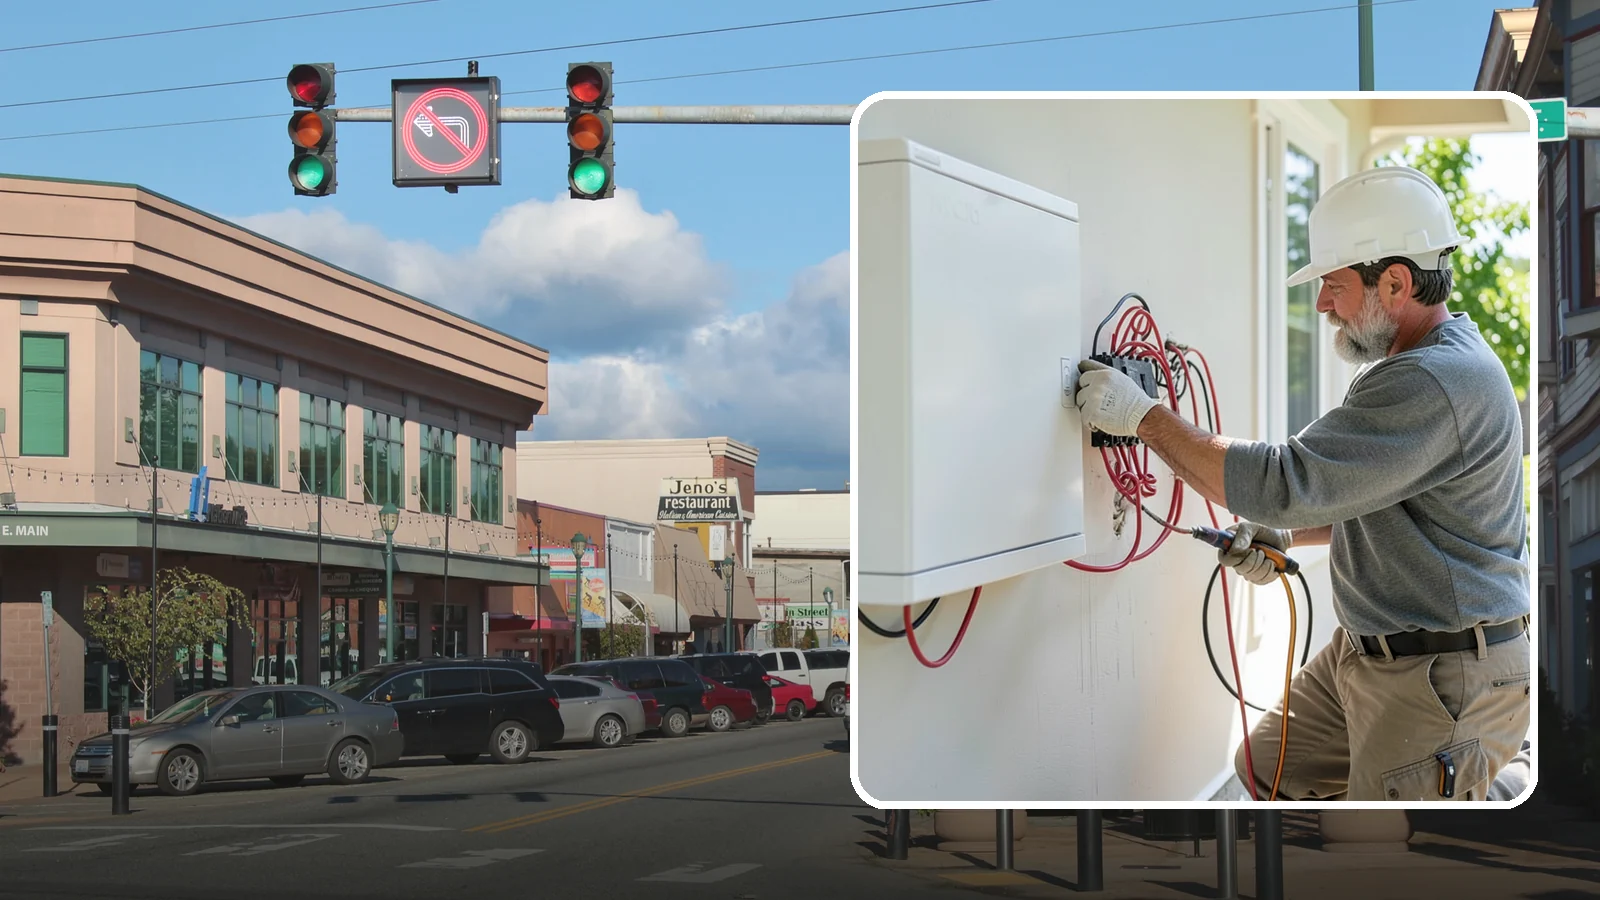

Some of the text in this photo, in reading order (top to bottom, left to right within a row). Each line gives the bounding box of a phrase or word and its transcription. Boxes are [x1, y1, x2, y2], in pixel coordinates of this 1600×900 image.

[669, 480, 727, 495] Jeno's
[665, 496, 731, 509] restaurant
[658, 510, 681, 520] Italian
[686, 509, 714, 519] American
[715, 509, 738, 519] Cuisine
[2, 525, 49, 536] E. MAIN
[798, 608, 828, 616] Street
[791, 619, 824, 627] lass
